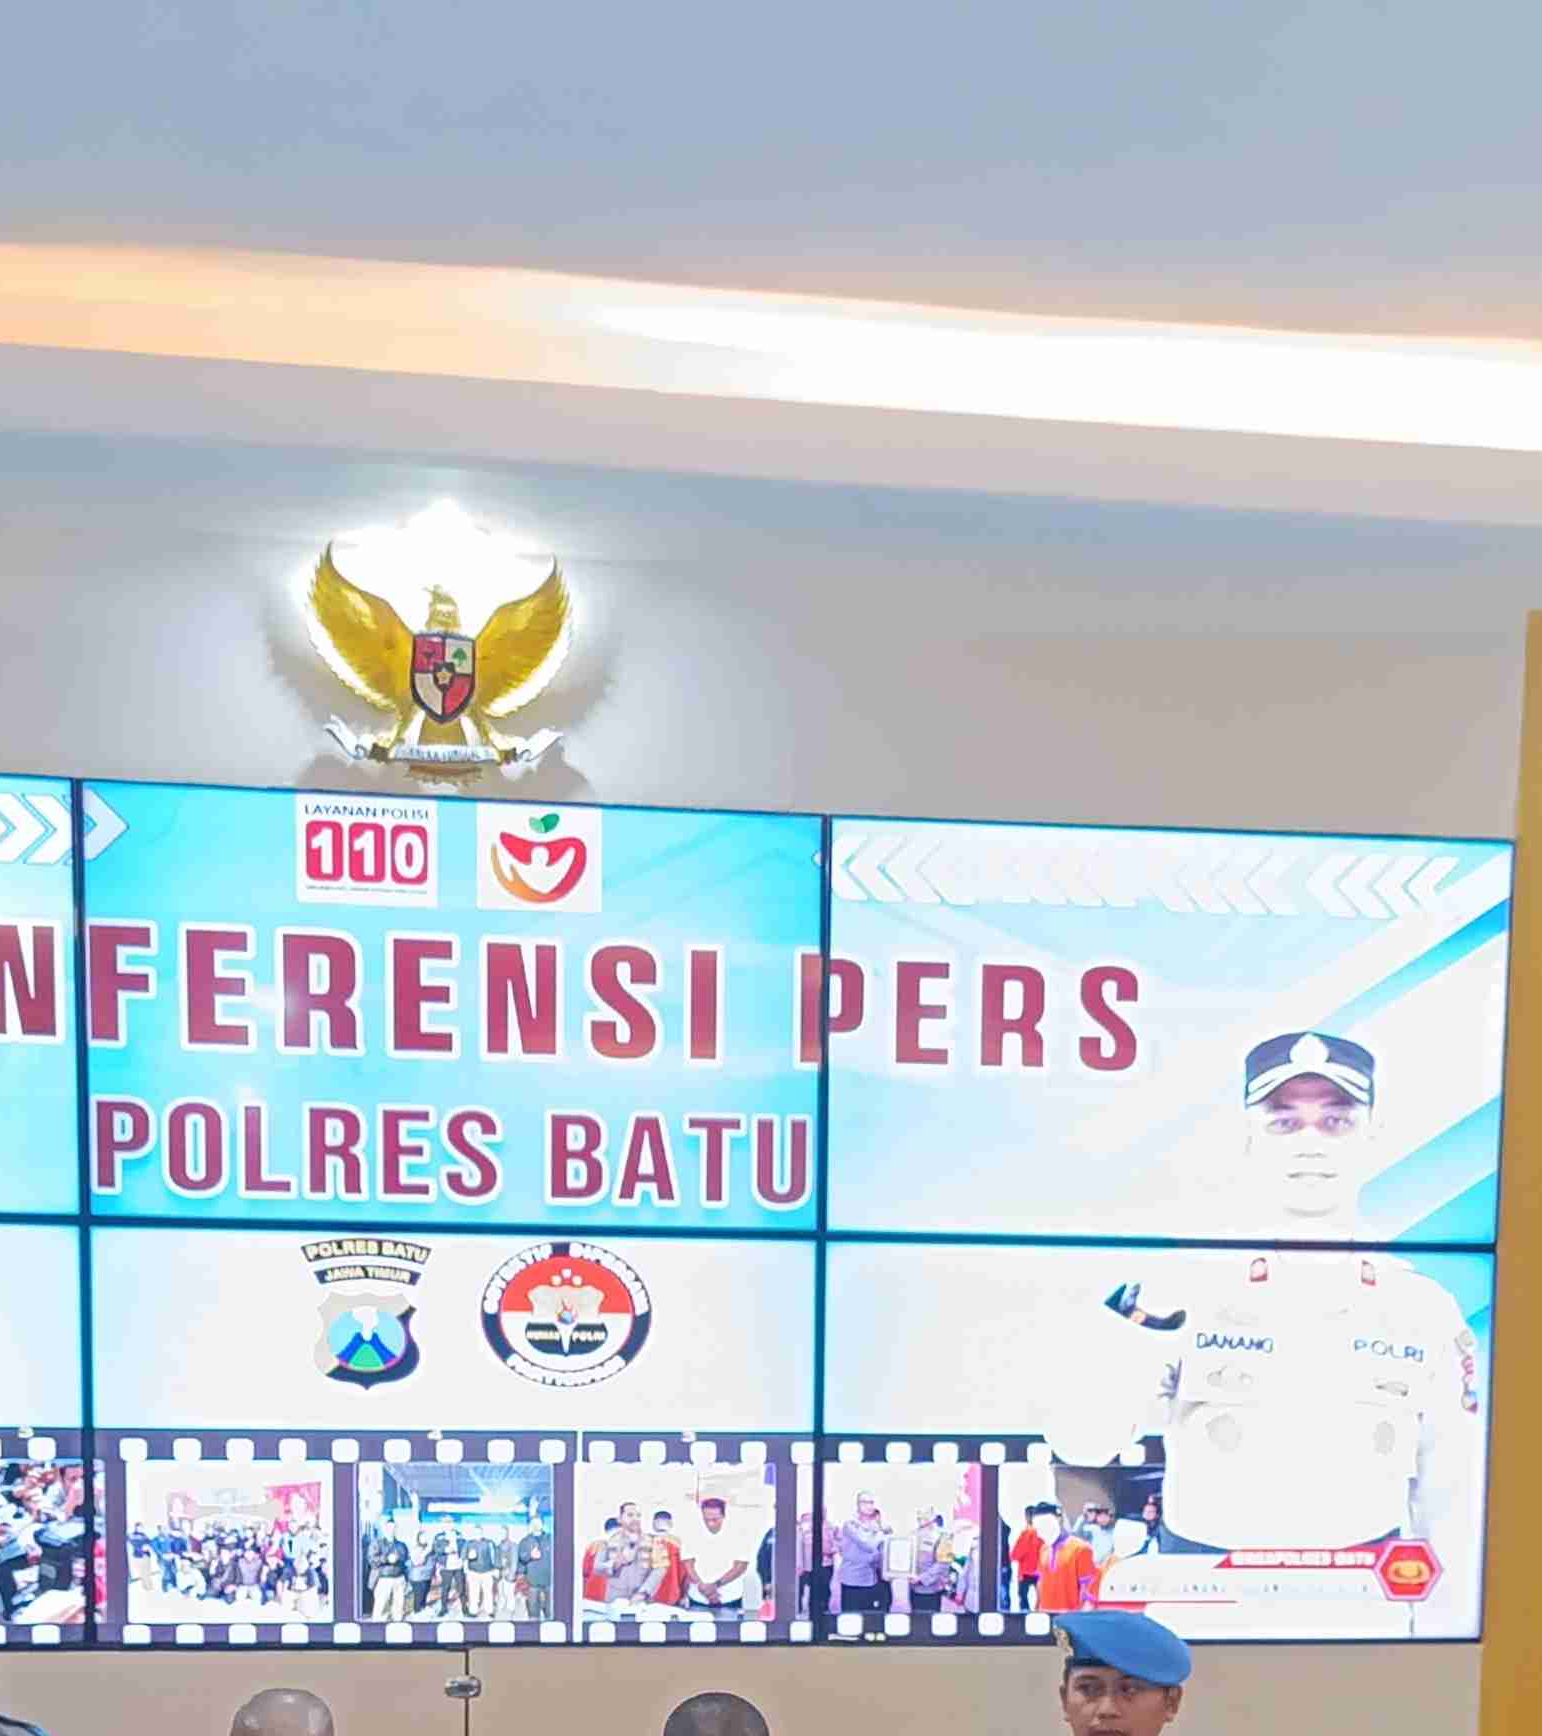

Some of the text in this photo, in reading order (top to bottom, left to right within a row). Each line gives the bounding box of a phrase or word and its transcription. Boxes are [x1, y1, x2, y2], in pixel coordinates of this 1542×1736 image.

[305, 804, 429, 820] LAYANAN POLISI
[310, 826, 426, 880] 110
[800, 953, 1140, 1072] PERS
[96, 1099, 808, 1203] POLRES BATU
[1354, 1338, 1424, 1362] POLRI
